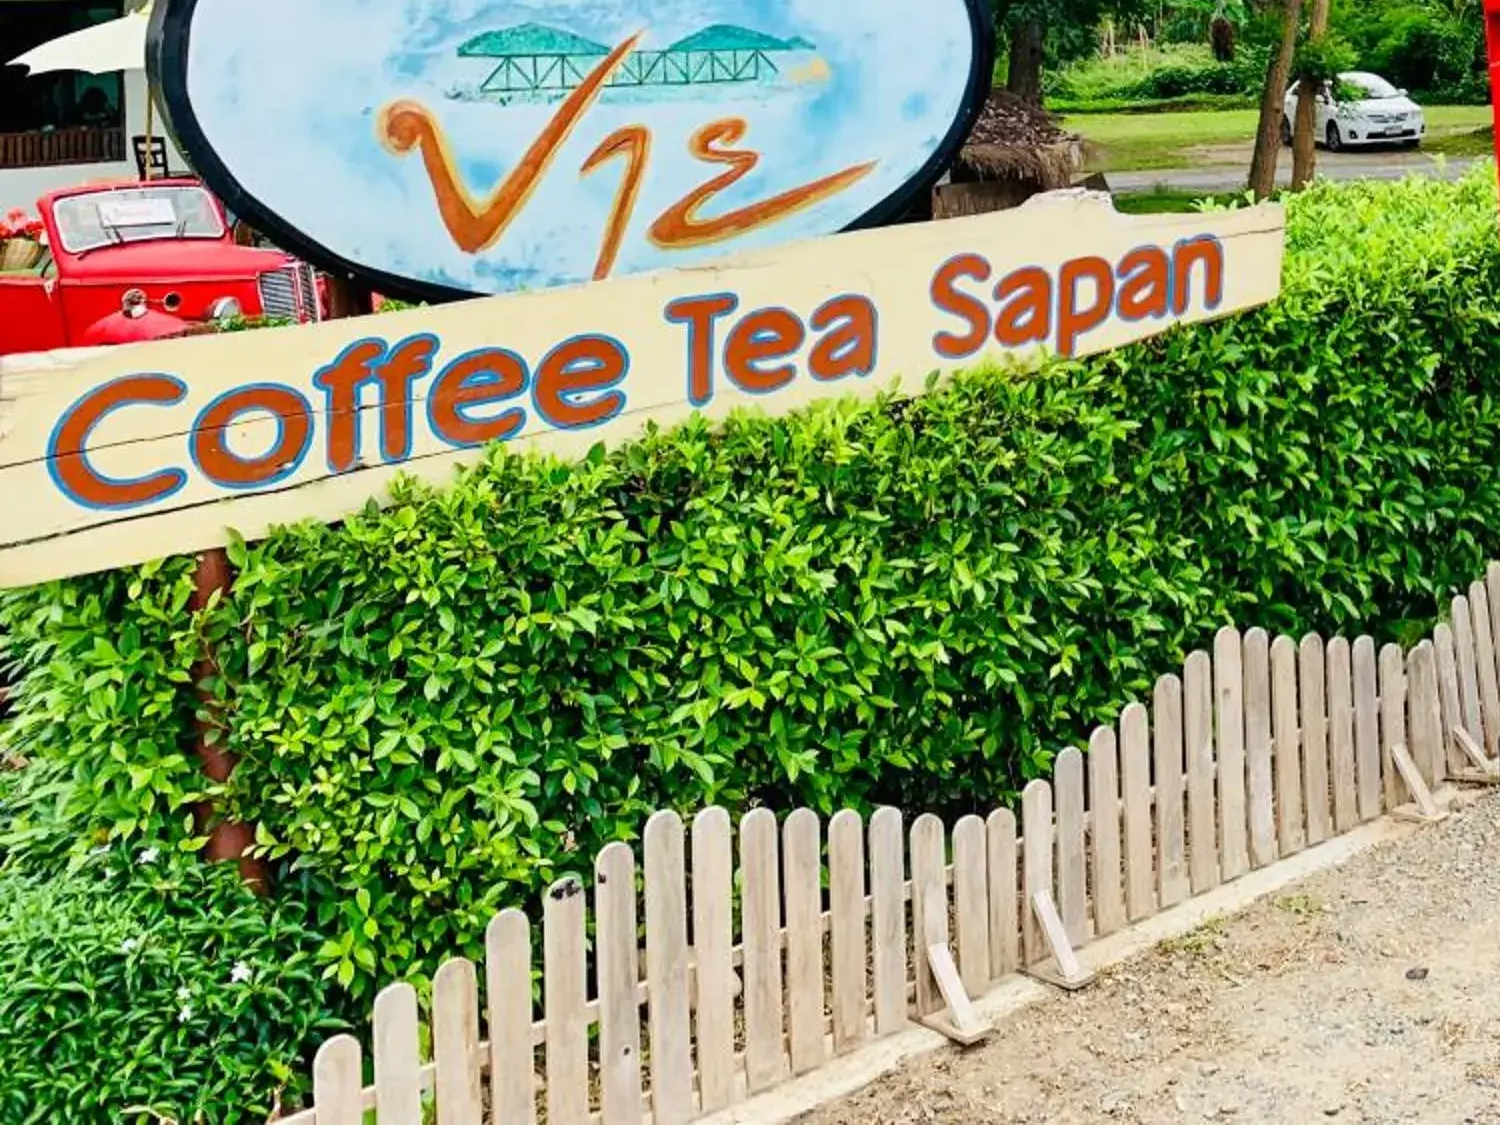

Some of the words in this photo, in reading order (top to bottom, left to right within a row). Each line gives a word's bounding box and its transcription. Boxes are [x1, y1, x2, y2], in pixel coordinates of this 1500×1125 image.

[46, 332, 631, 511] Coffee
[664, 291, 879, 408] Tea
[930, 233, 1225, 359] Sapan
